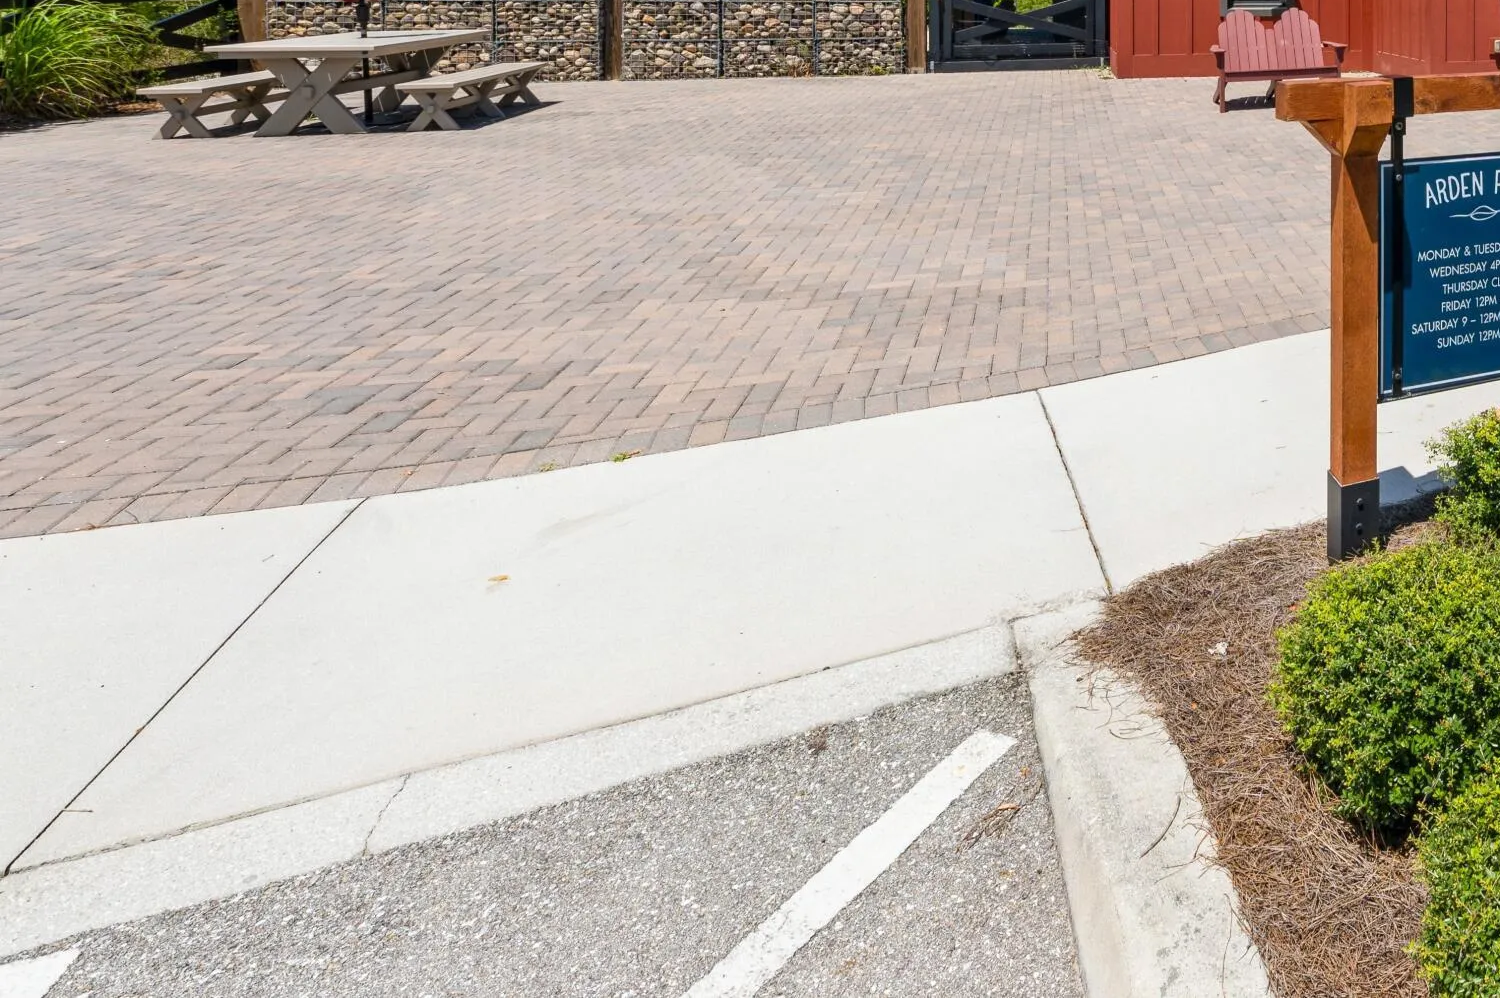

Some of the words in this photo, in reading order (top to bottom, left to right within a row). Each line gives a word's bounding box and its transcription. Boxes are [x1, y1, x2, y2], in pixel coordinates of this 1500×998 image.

[1425, 170, 1484, 209] ARDEN
[1417, 247, 1461, 263] MONDAY
[1463, 245, 1471, 257] &
[1429, 261, 1488, 278] WEDNESDAY
[1442, 278, 1489, 295] THURSDAY
[1441, 298, 1472, 313] FRIDAY
[1475, 295, 1498, 308] 12PM
[1411, 317, 1459, 336] SATURDAY
[1461, 316, 1468, 327] 9
[1437, 332, 1475, 349] SUNDAY
[1479, 328, 1500, 342] 12PM
